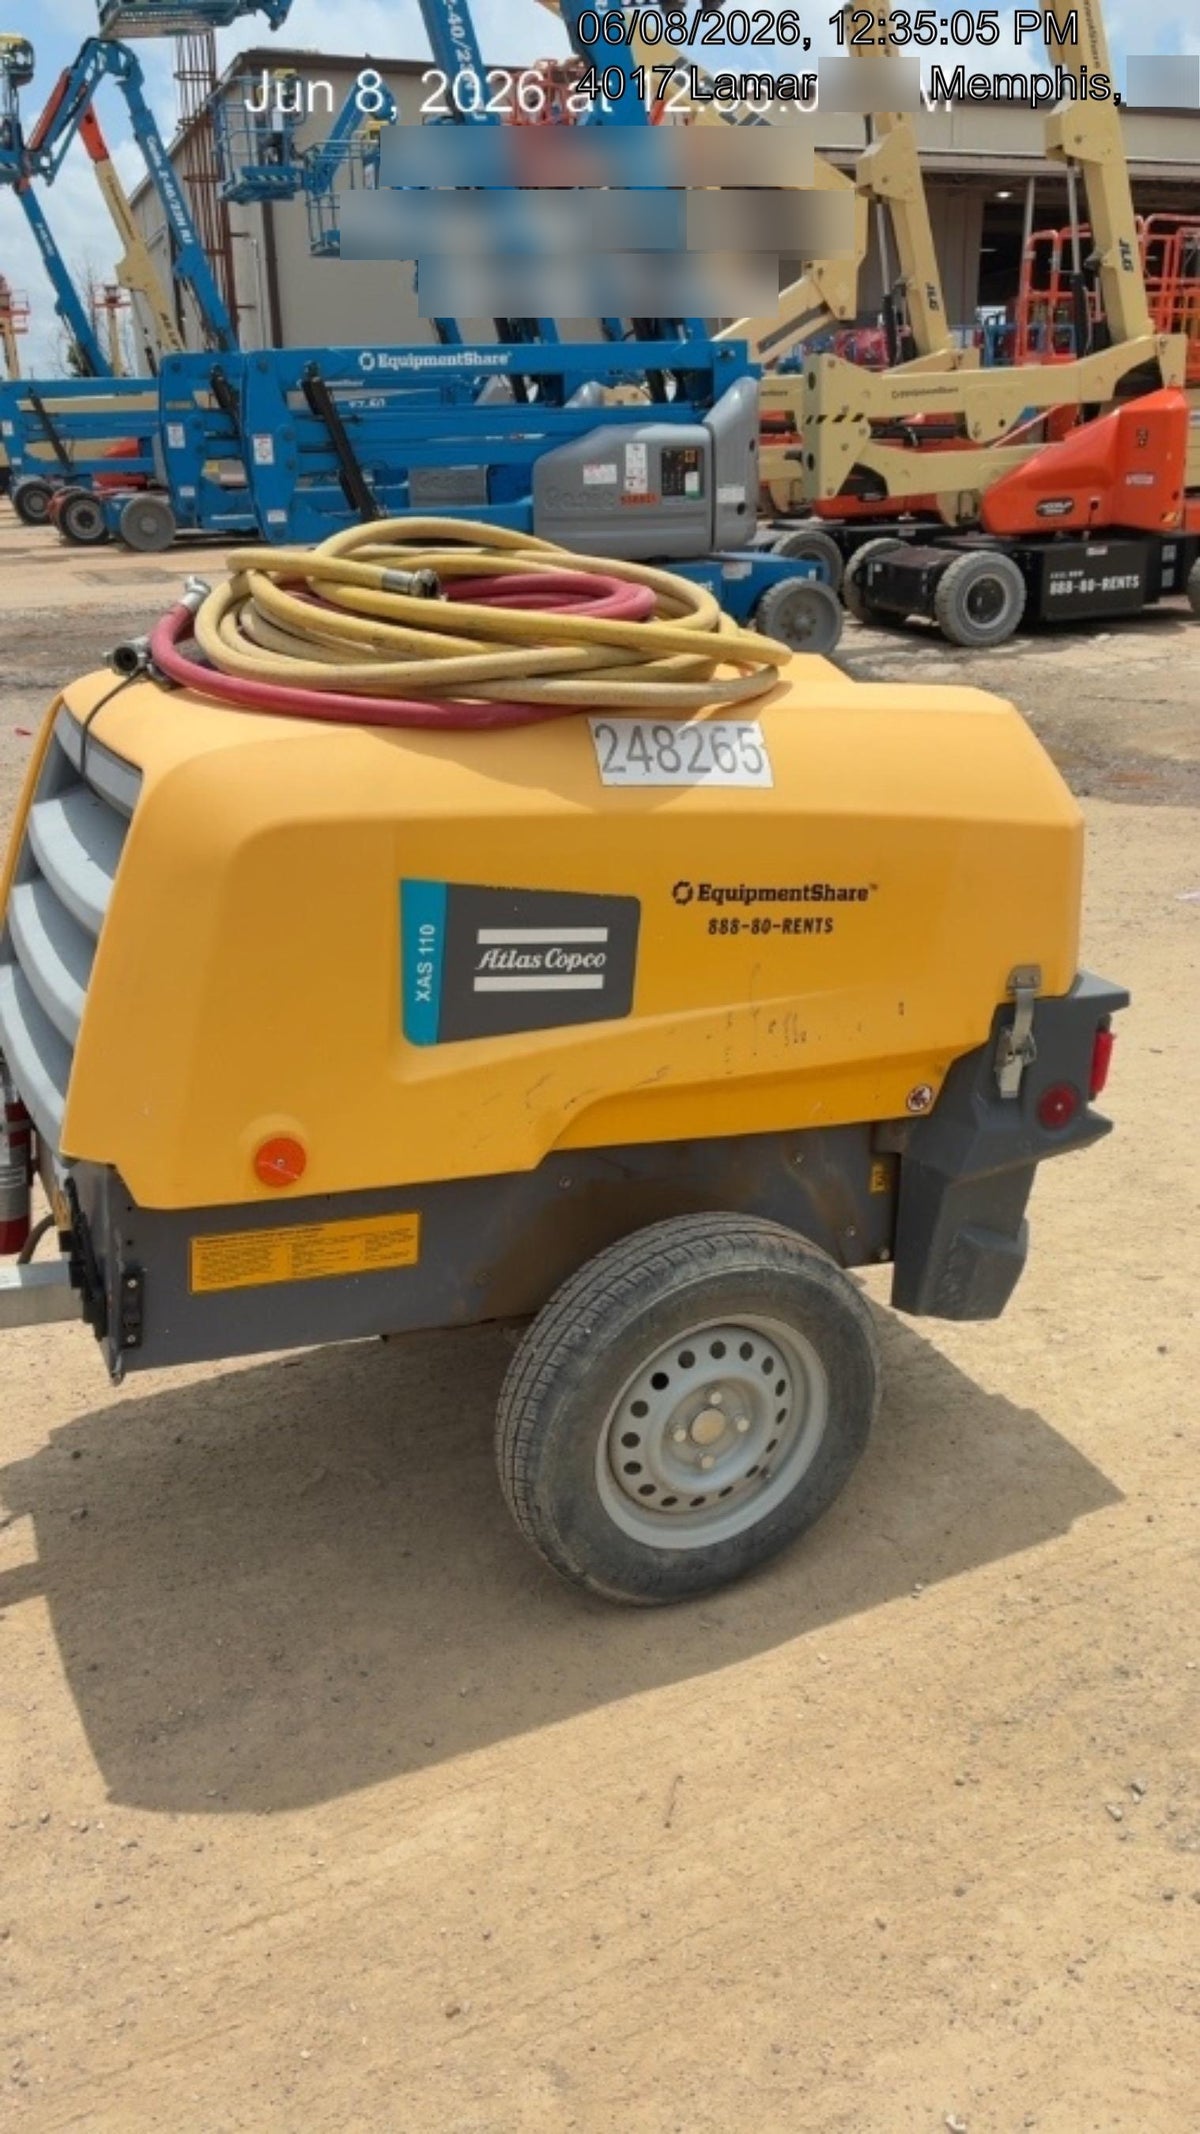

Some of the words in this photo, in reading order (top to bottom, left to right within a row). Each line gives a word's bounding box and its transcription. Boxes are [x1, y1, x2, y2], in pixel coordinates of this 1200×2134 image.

[1118, 238, 1135, 273] JLG
[377, 352, 511, 371] EquipmentShare
[594, 723, 765, 774] 248265
[696, 883, 869, 907] EquipmentShare
[418, 924, 436, 954] 110
[707, 917, 834, 936] 888-80-RENTS
[475, 948, 543, 970] Atlas
[545, 947, 607, 973] Copco
[415, 961, 433, 1002] XAS
